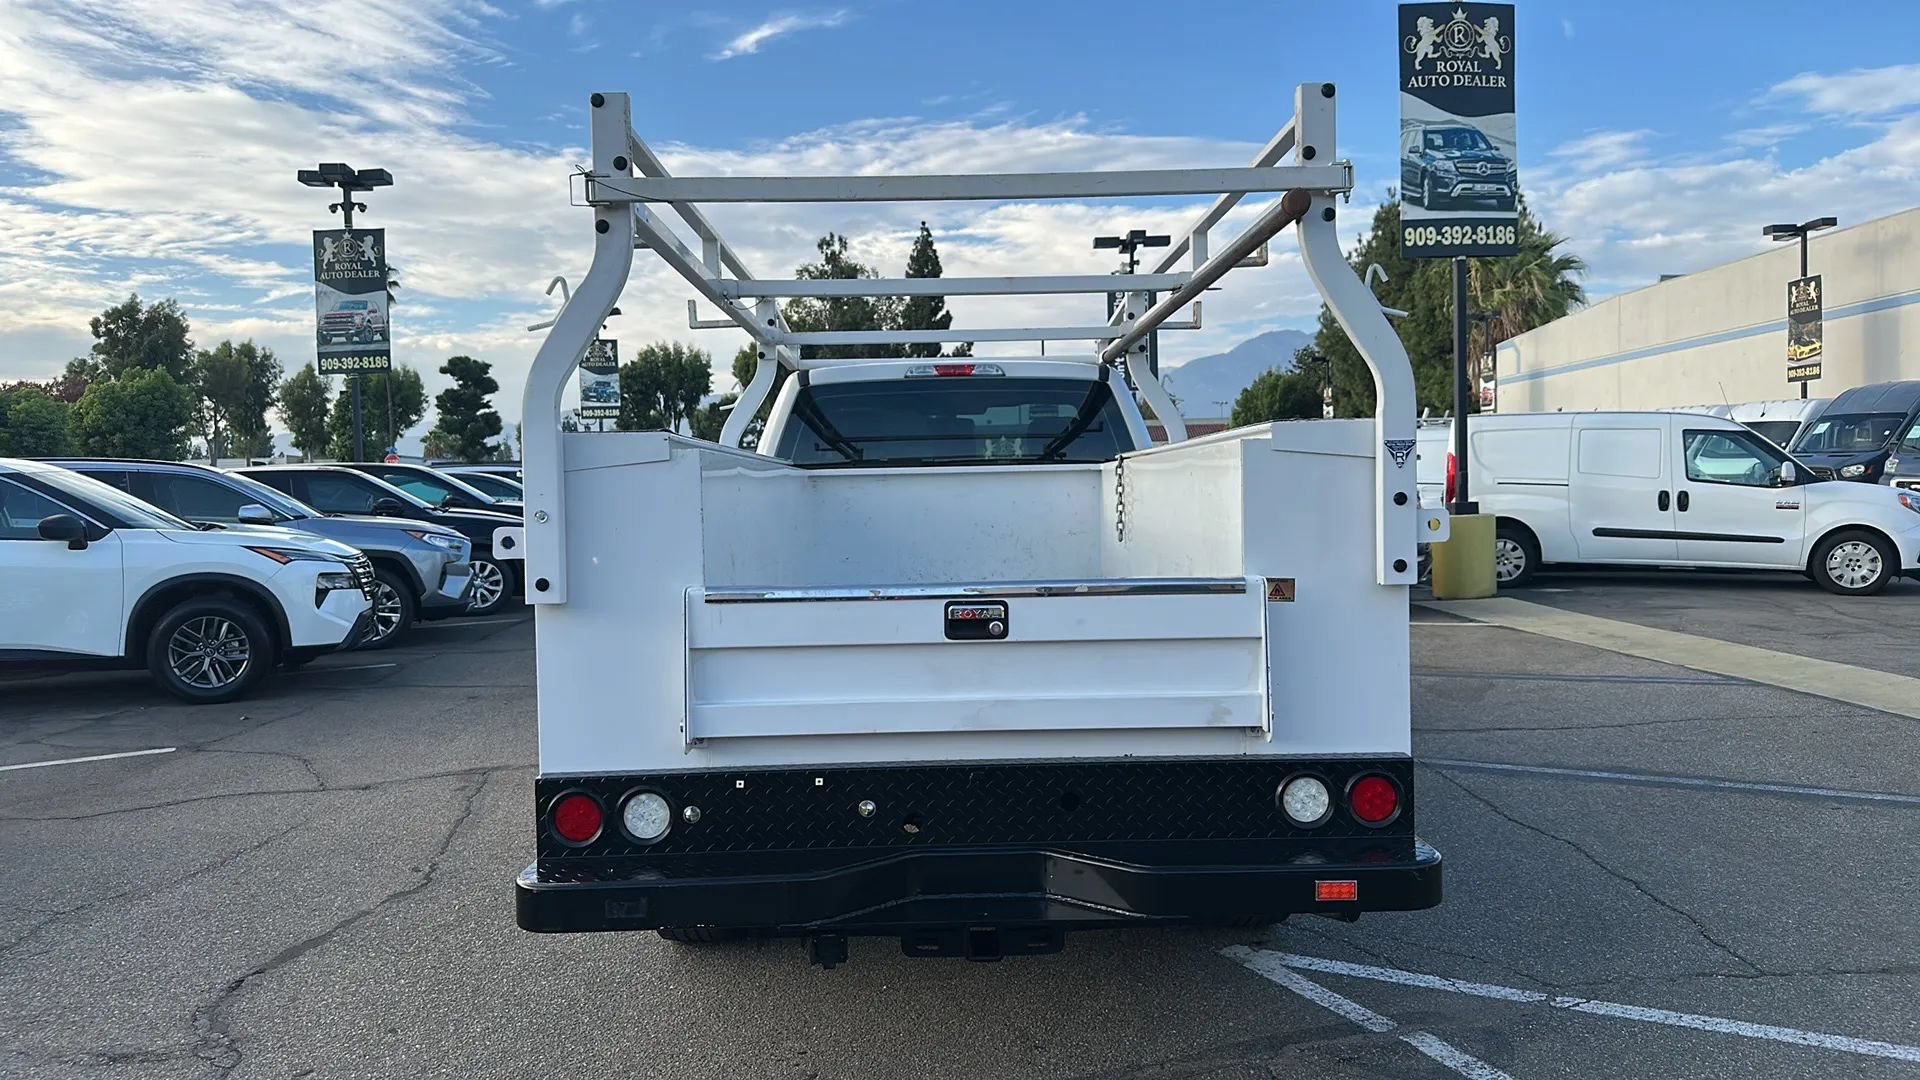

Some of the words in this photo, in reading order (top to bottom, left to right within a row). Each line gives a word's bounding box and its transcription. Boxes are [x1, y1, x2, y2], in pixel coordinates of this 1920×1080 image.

[1436, 60, 1482, 73] ROYAL
[1408, 75, 1450, 88] AUTO
[1453, 75, 1507, 88] DEALER
[1404, 225, 1516, 247] 909-392-8186
[334, 262, 363, 271] ROYAL
[320, 271, 343, 280] AUTO
[344, 270, 380, 279] DEALER
[320, 356, 389, 371] 909-392-8186
[954, 609, 999, 618] ROYAL
